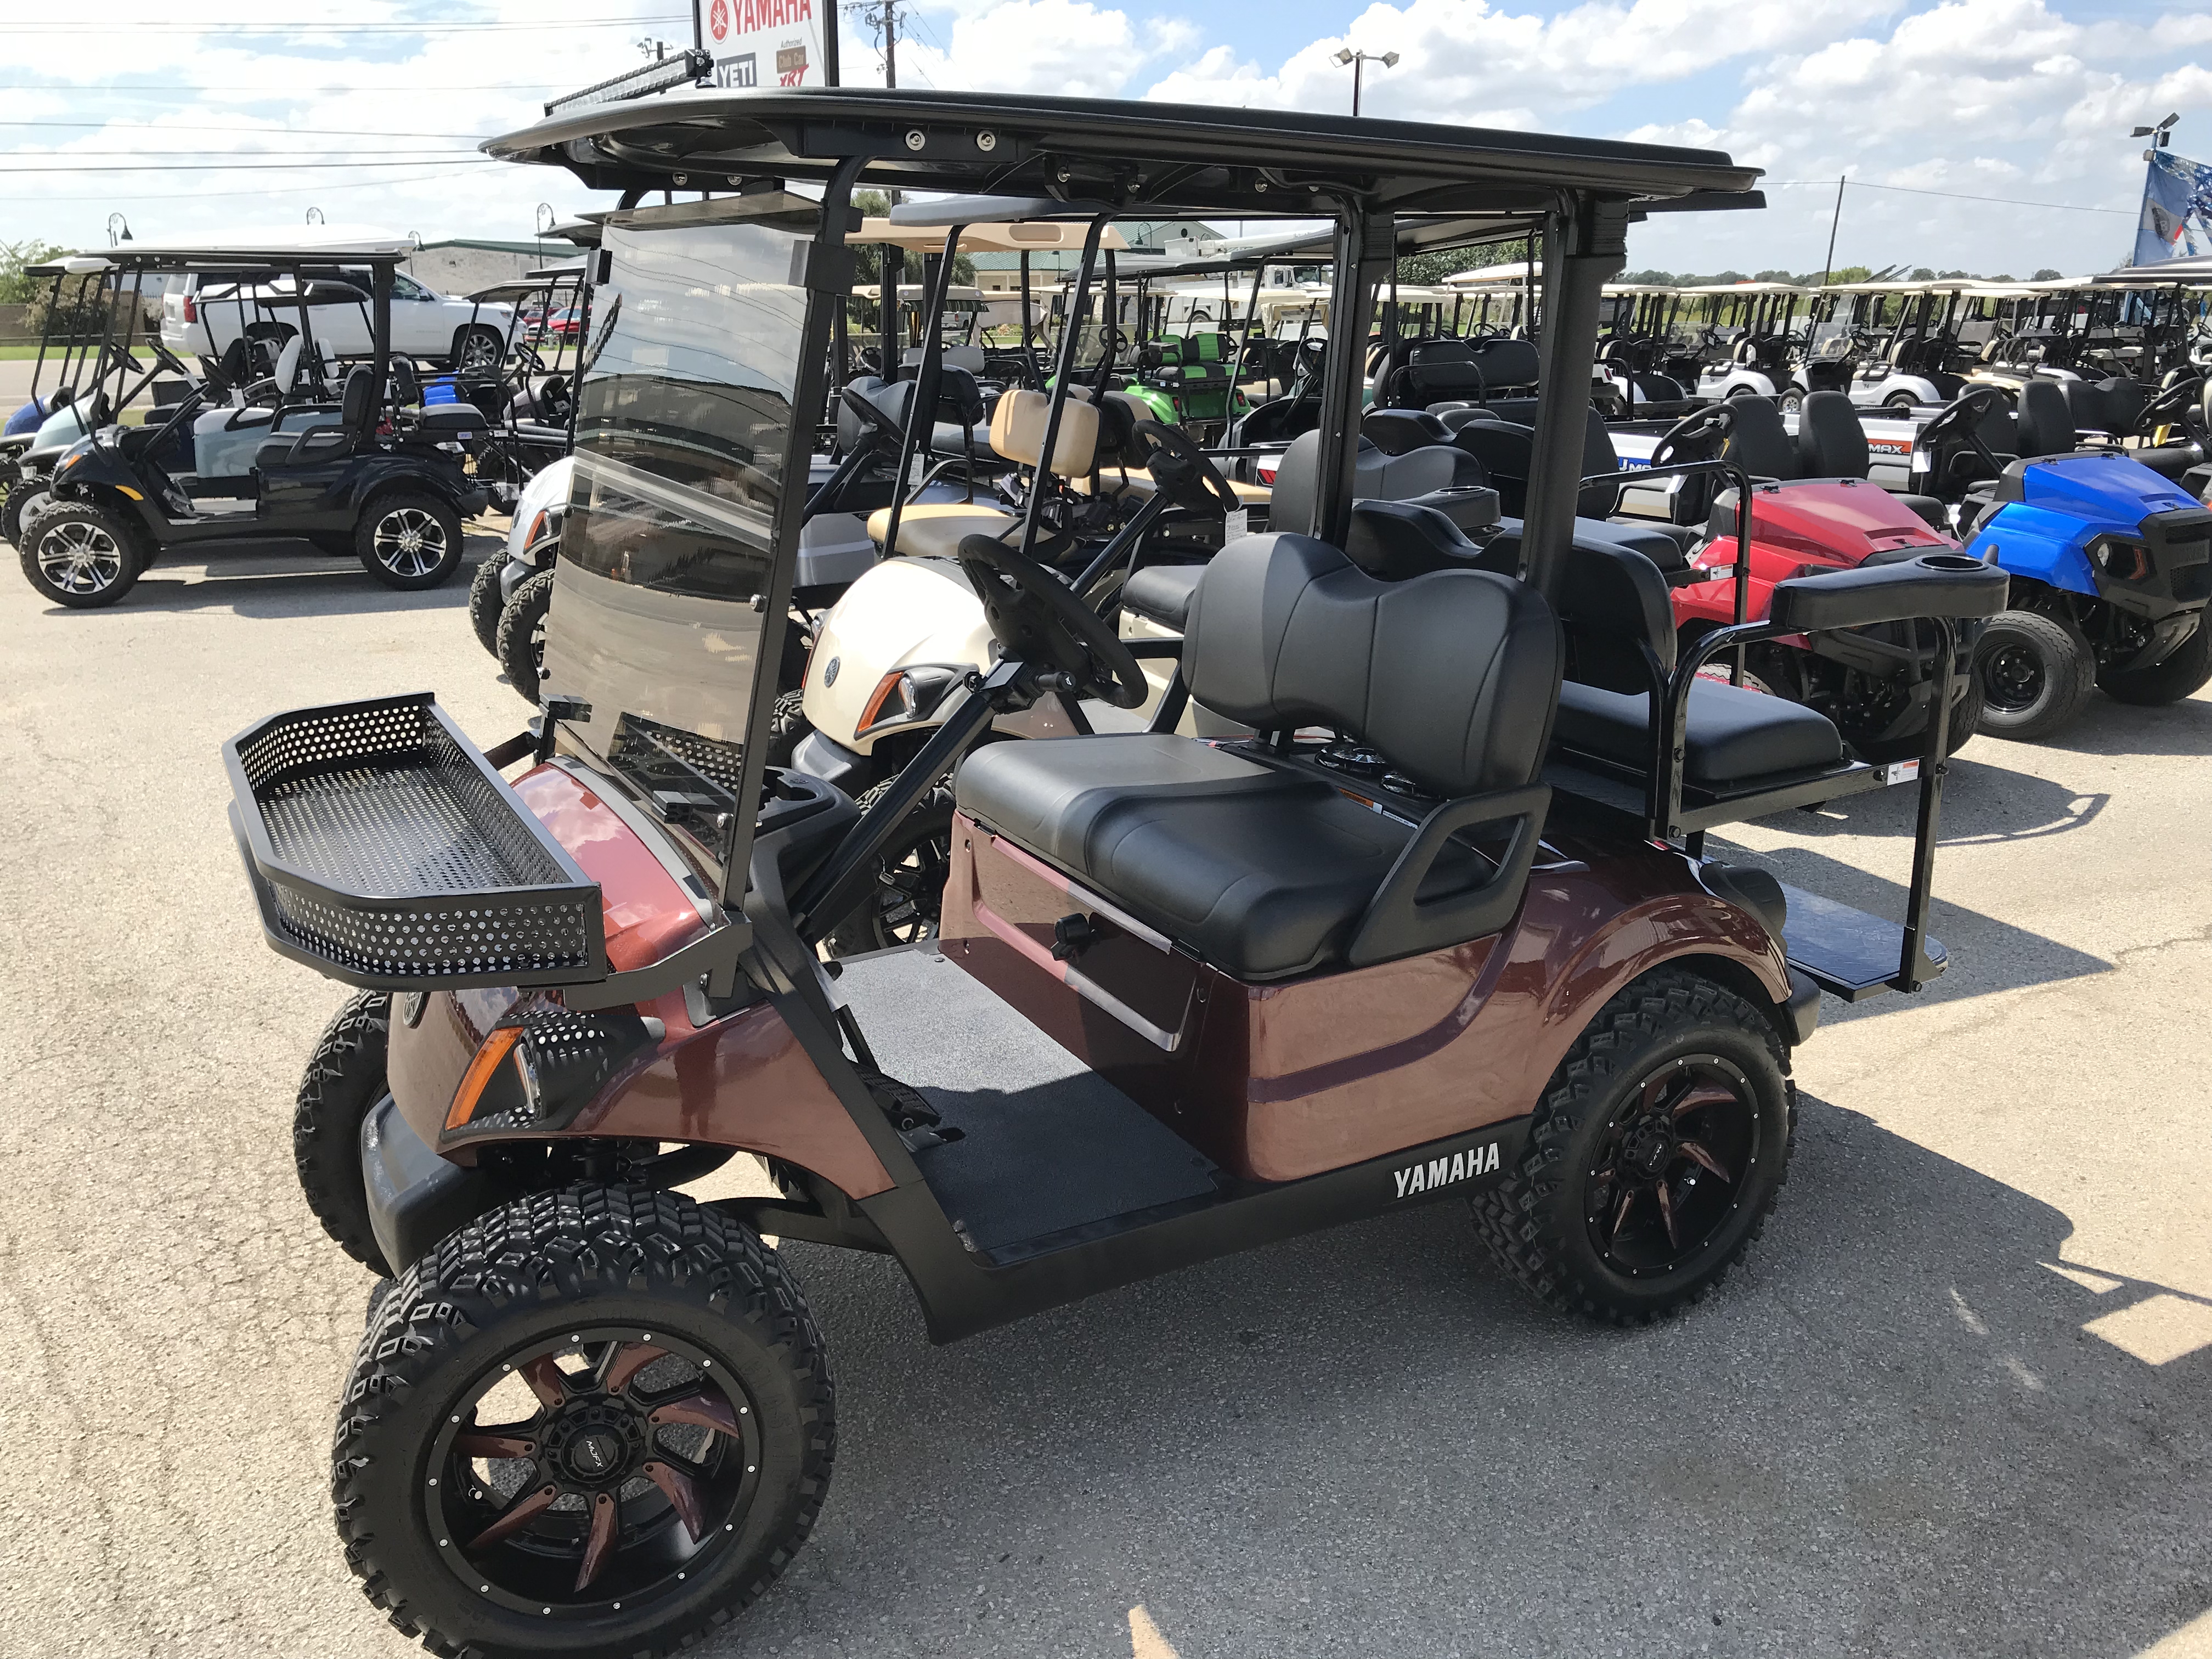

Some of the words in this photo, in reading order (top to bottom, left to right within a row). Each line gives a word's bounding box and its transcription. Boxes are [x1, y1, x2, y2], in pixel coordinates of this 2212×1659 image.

[733, 0, 812, 35] YAMAHA
[781, 36, 802, 49] Authorized
[718, 60, 754, 87] YETI
[778, 54, 792, 69] Club
[793, 52, 805, 66] Car
[1393, 1142, 1500, 1199] YAMAHA
